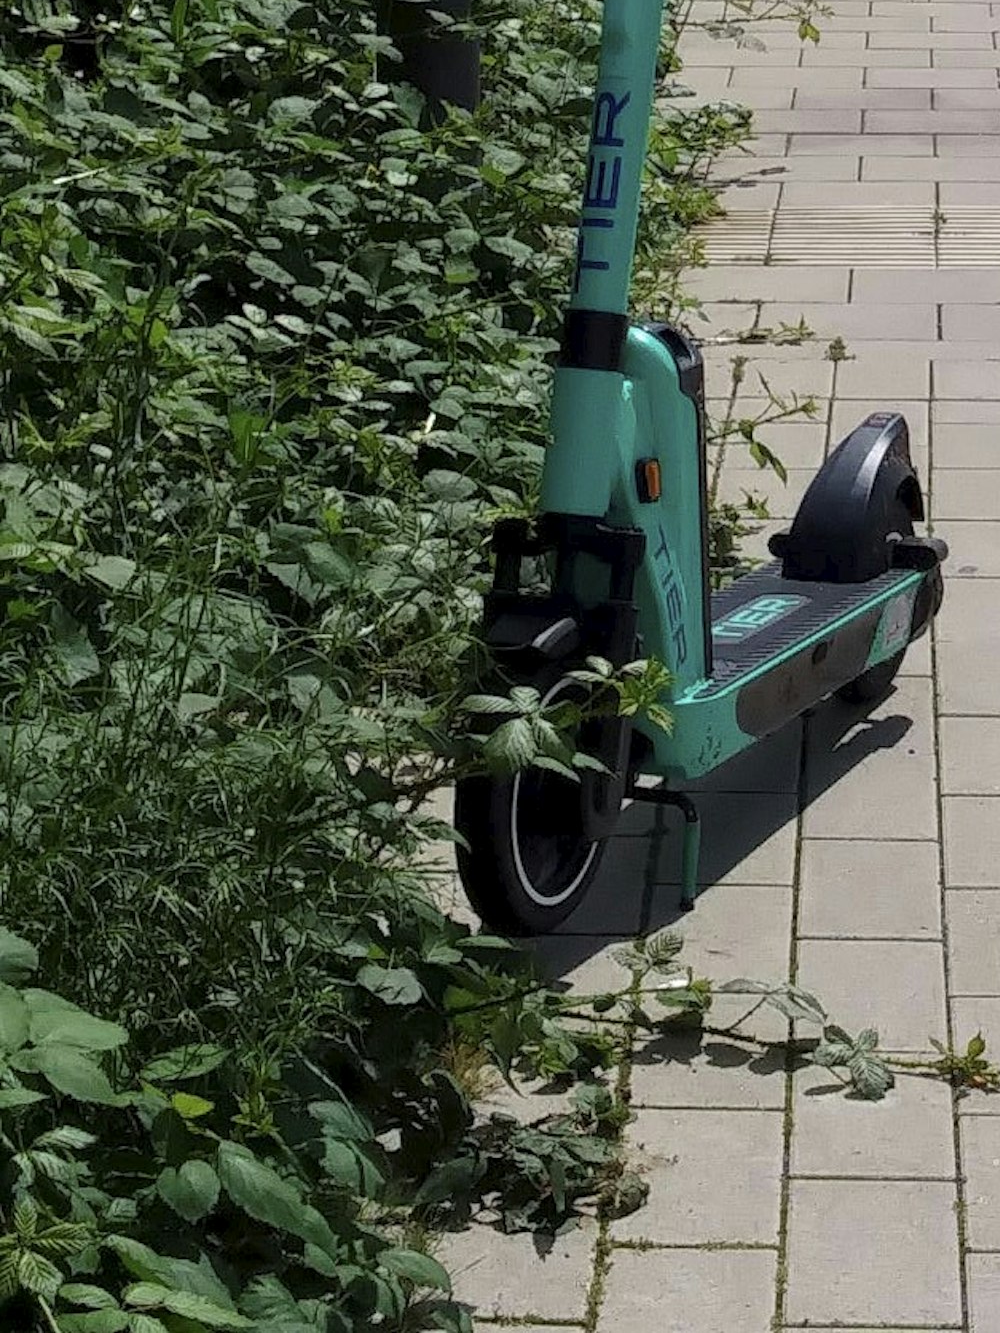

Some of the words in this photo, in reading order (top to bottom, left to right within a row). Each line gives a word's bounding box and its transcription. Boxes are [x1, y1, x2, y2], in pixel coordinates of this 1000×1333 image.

[573, 91, 631, 294] TIER
[654, 524, 688, 670] TIER
[712, 598, 801, 637] TIER
